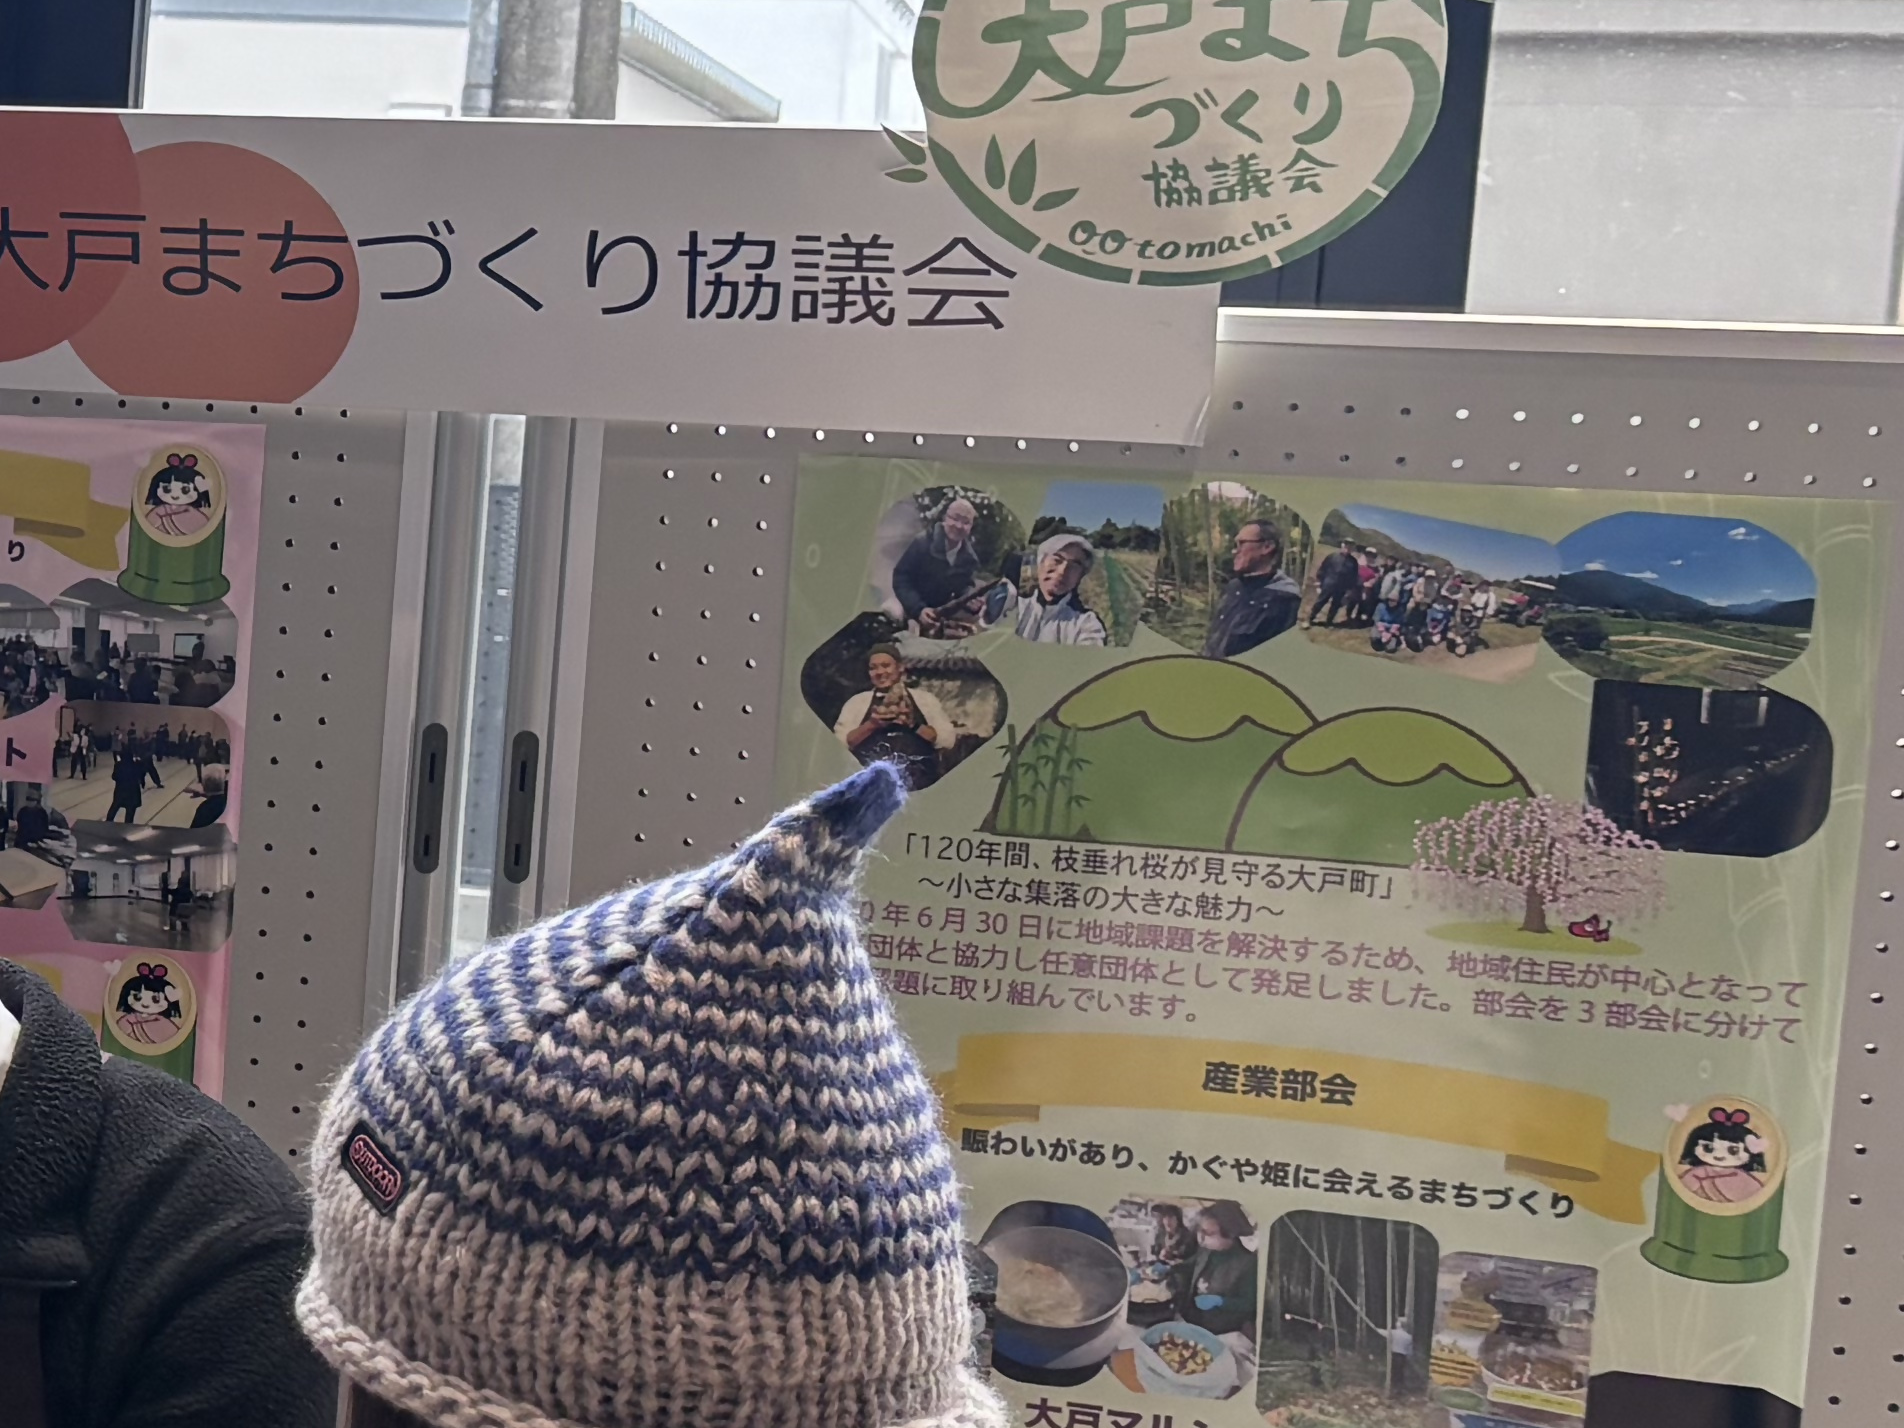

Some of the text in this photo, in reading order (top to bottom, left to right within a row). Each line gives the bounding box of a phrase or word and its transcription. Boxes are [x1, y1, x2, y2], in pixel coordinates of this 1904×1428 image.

[1129, 78, 1345, 151] づくり
[1140, 147, 1340, 209] 協議会
[1201, 1060, 1358, 1107] 産業部会
